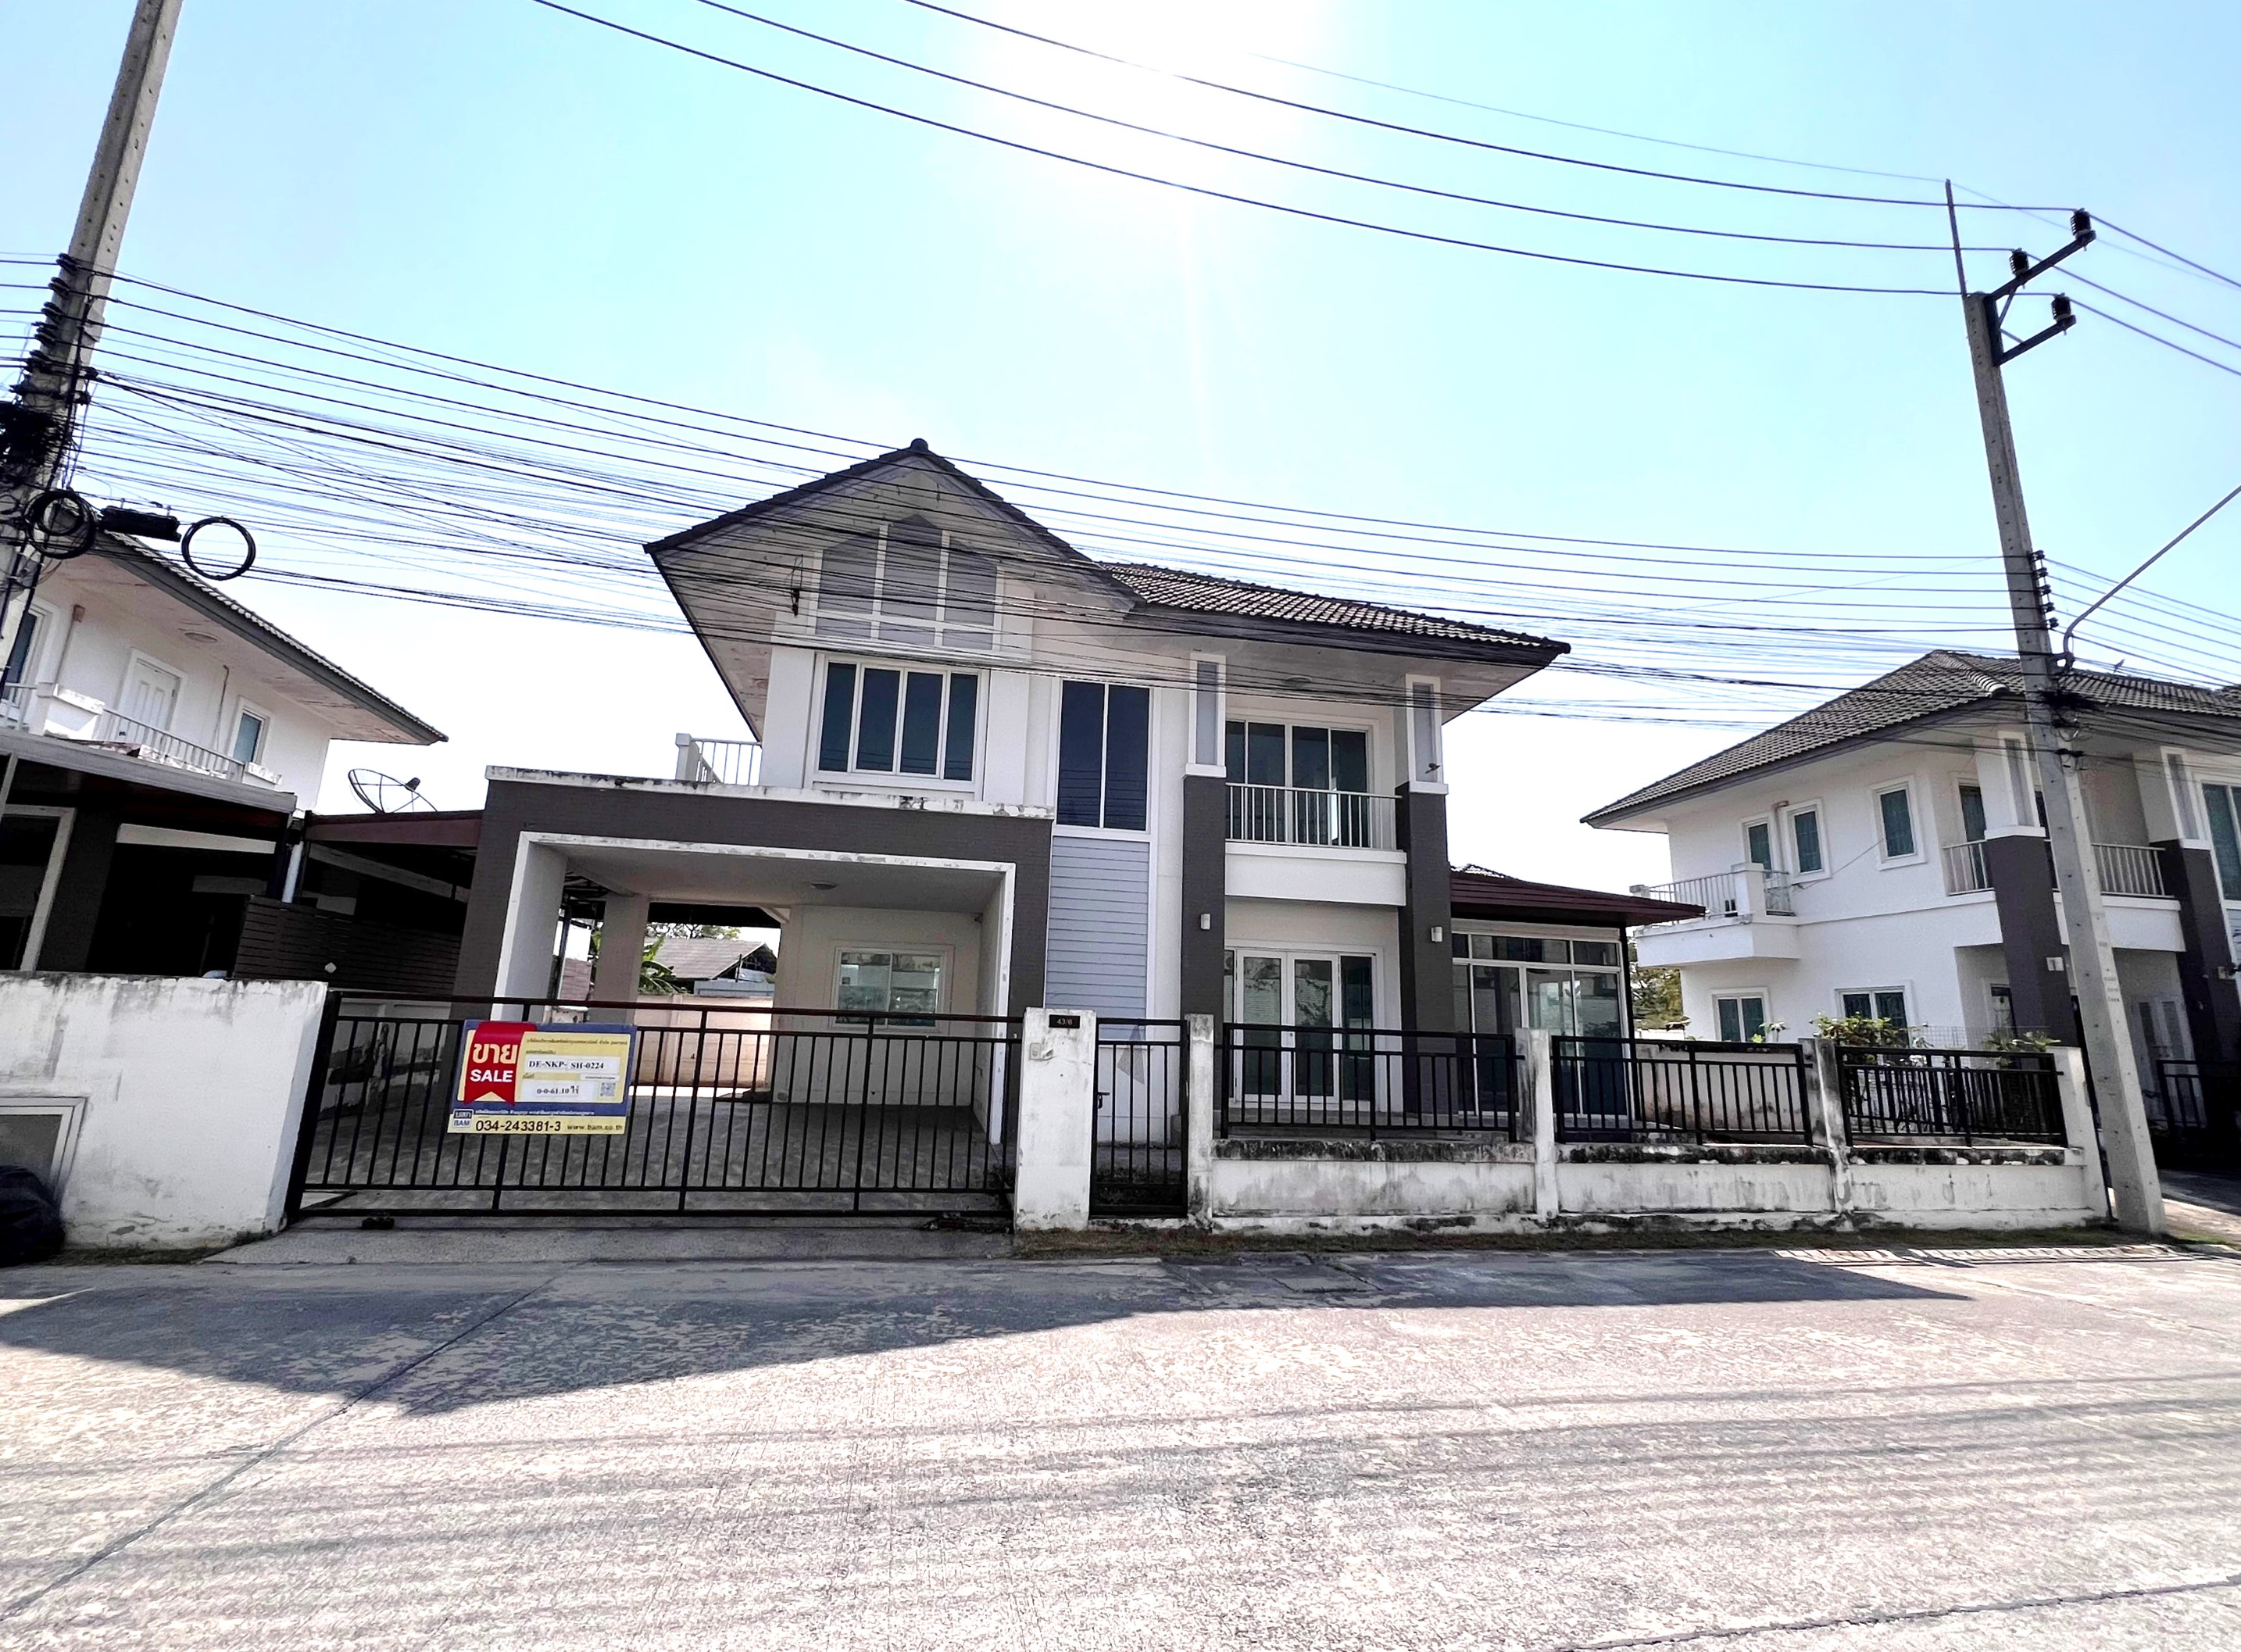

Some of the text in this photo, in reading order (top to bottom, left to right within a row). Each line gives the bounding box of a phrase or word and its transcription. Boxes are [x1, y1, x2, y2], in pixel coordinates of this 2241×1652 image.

[473, 1043, 519, 1064] ขาย
[470, 1068, 513, 1083] SALE
[476, 1120, 561, 1132] 034-243381-3
